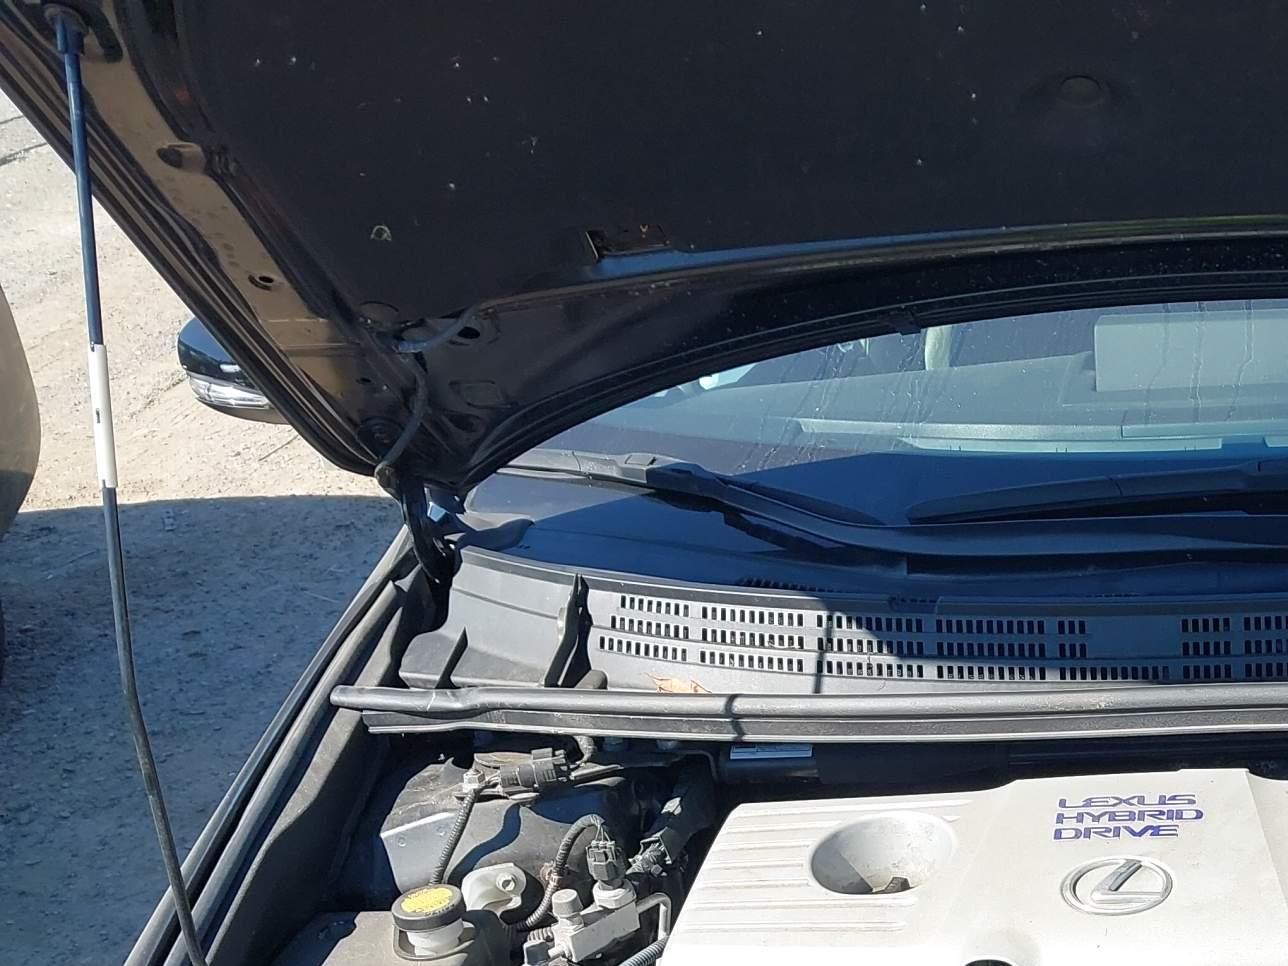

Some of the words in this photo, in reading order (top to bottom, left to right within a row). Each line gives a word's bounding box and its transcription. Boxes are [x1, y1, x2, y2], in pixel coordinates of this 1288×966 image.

[1058, 794, 1196, 809] LEXUS
[1056, 809, 1203, 824] HYBRID
[1053, 825, 1180, 840] DRIVE
